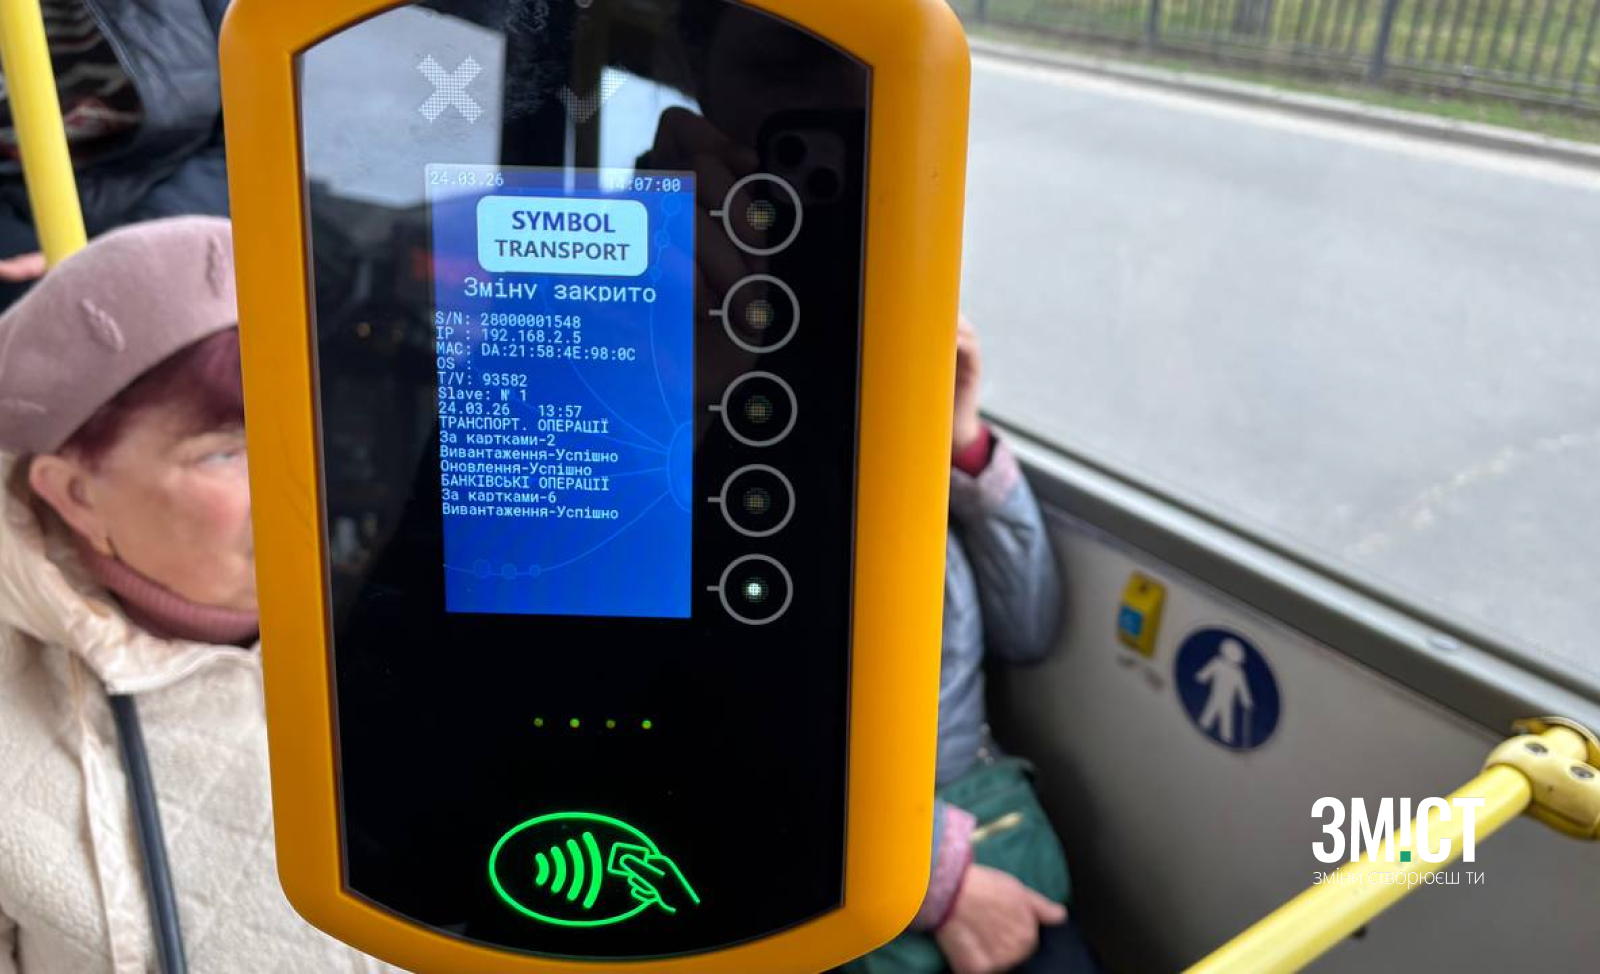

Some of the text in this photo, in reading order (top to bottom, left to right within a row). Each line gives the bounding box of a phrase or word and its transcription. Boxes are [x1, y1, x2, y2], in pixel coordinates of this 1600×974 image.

[430, 172, 504, 187] 24.03.26
[512, 210, 616, 233] SYMBOL
[494, 239, 630, 261] TRANSPORT
[554, 283, 657, 303] закрито
[435, 311, 582, 329] S/N: 28000001548
[436, 326, 454, 340] IP
[482, 328, 582, 344] 192.168.2.5
[436, 342, 636, 361] MAC: DA:21:58:4E:98:0C
[436, 357, 455, 370] OS
[437, 371, 528, 387] T/V: 93582
[438, 387, 491, 401] Slave:
[520, 389, 527, 401] 1
[438, 402, 582, 418] 24.03.26 13:57
[439, 415, 528, 431] ТРАНСПОРТ.
[440, 430, 556, 446] За картками-2
[439, 445, 619, 462] Вивантаження-Успішно
[440, 460, 593, 476] Оновлення-Успішно
[441, 473, 531, 489] БАНКІВСЬКІ
[441, 488, 557, 504] За картками-6
[442, 503, 620, 519] Вивантаження-Успішно
